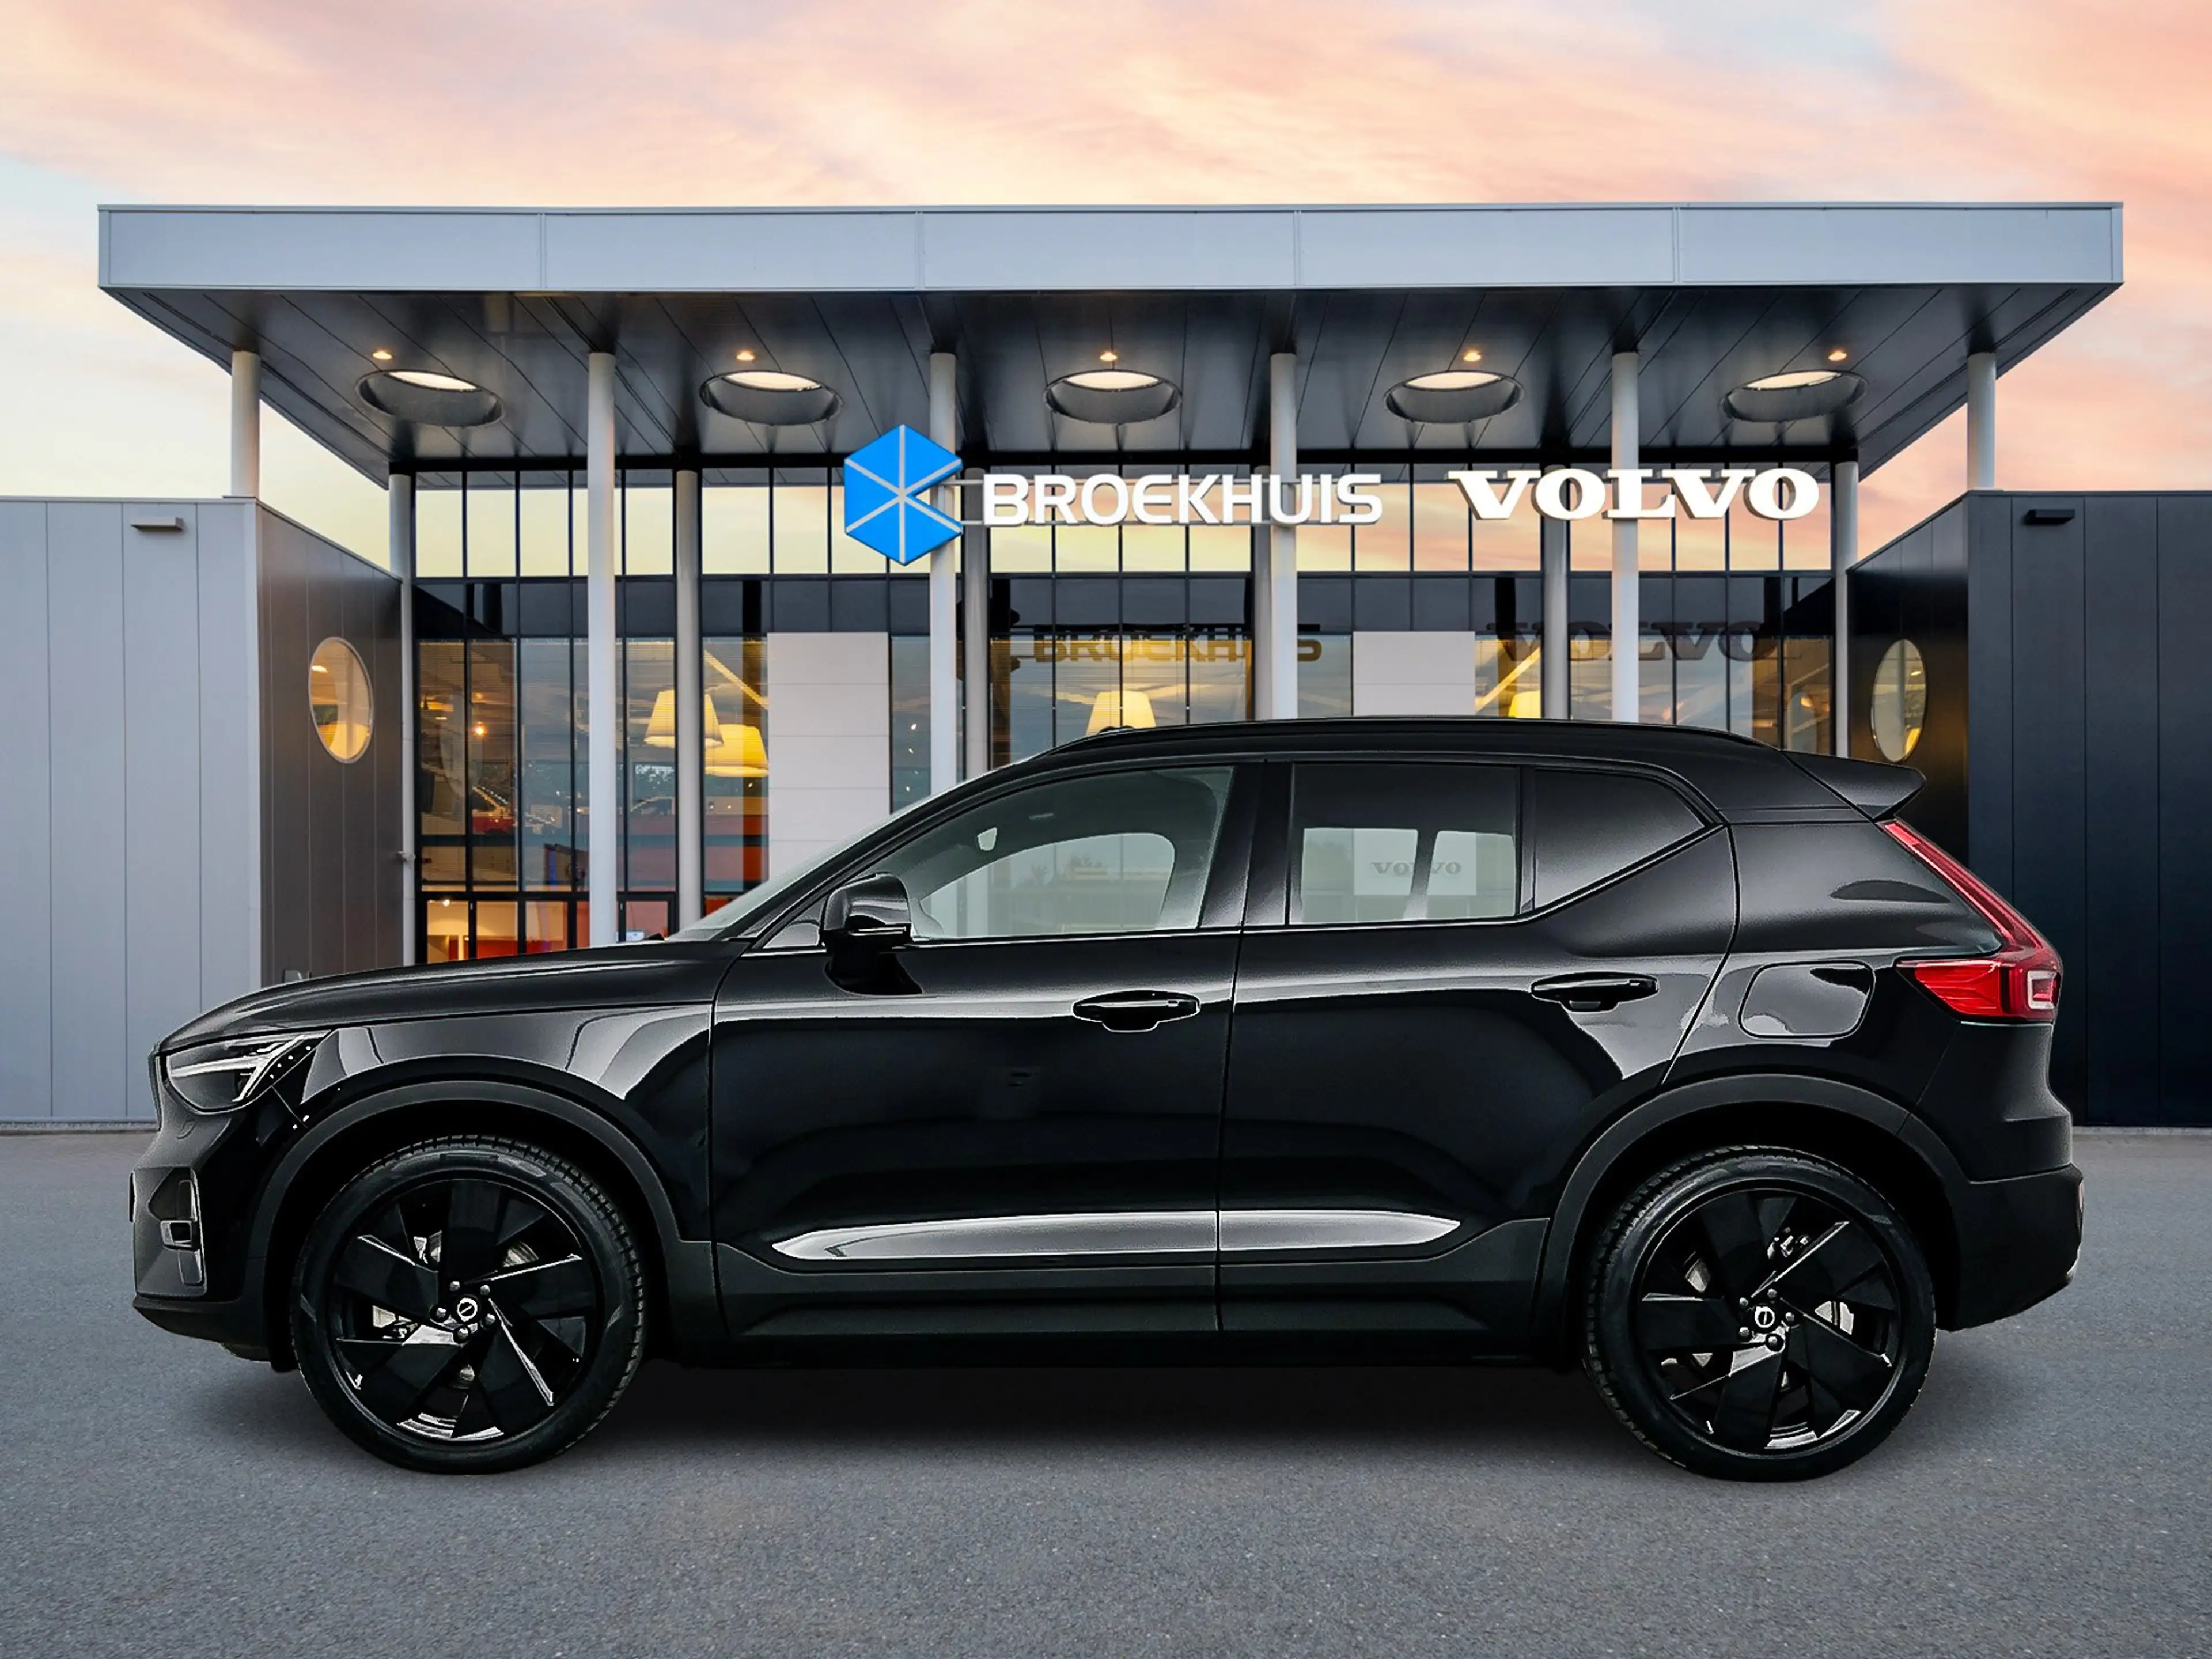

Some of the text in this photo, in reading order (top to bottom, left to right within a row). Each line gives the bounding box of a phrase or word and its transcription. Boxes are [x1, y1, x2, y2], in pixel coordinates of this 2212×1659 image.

[983, 474, 1383, 526] BROEKHUIS
[1444, 468, 1819, 520] VOLVO
[1031, 627, 1322, 662] BROEKHS
[1370, 861, 1462, 875] VOVO
